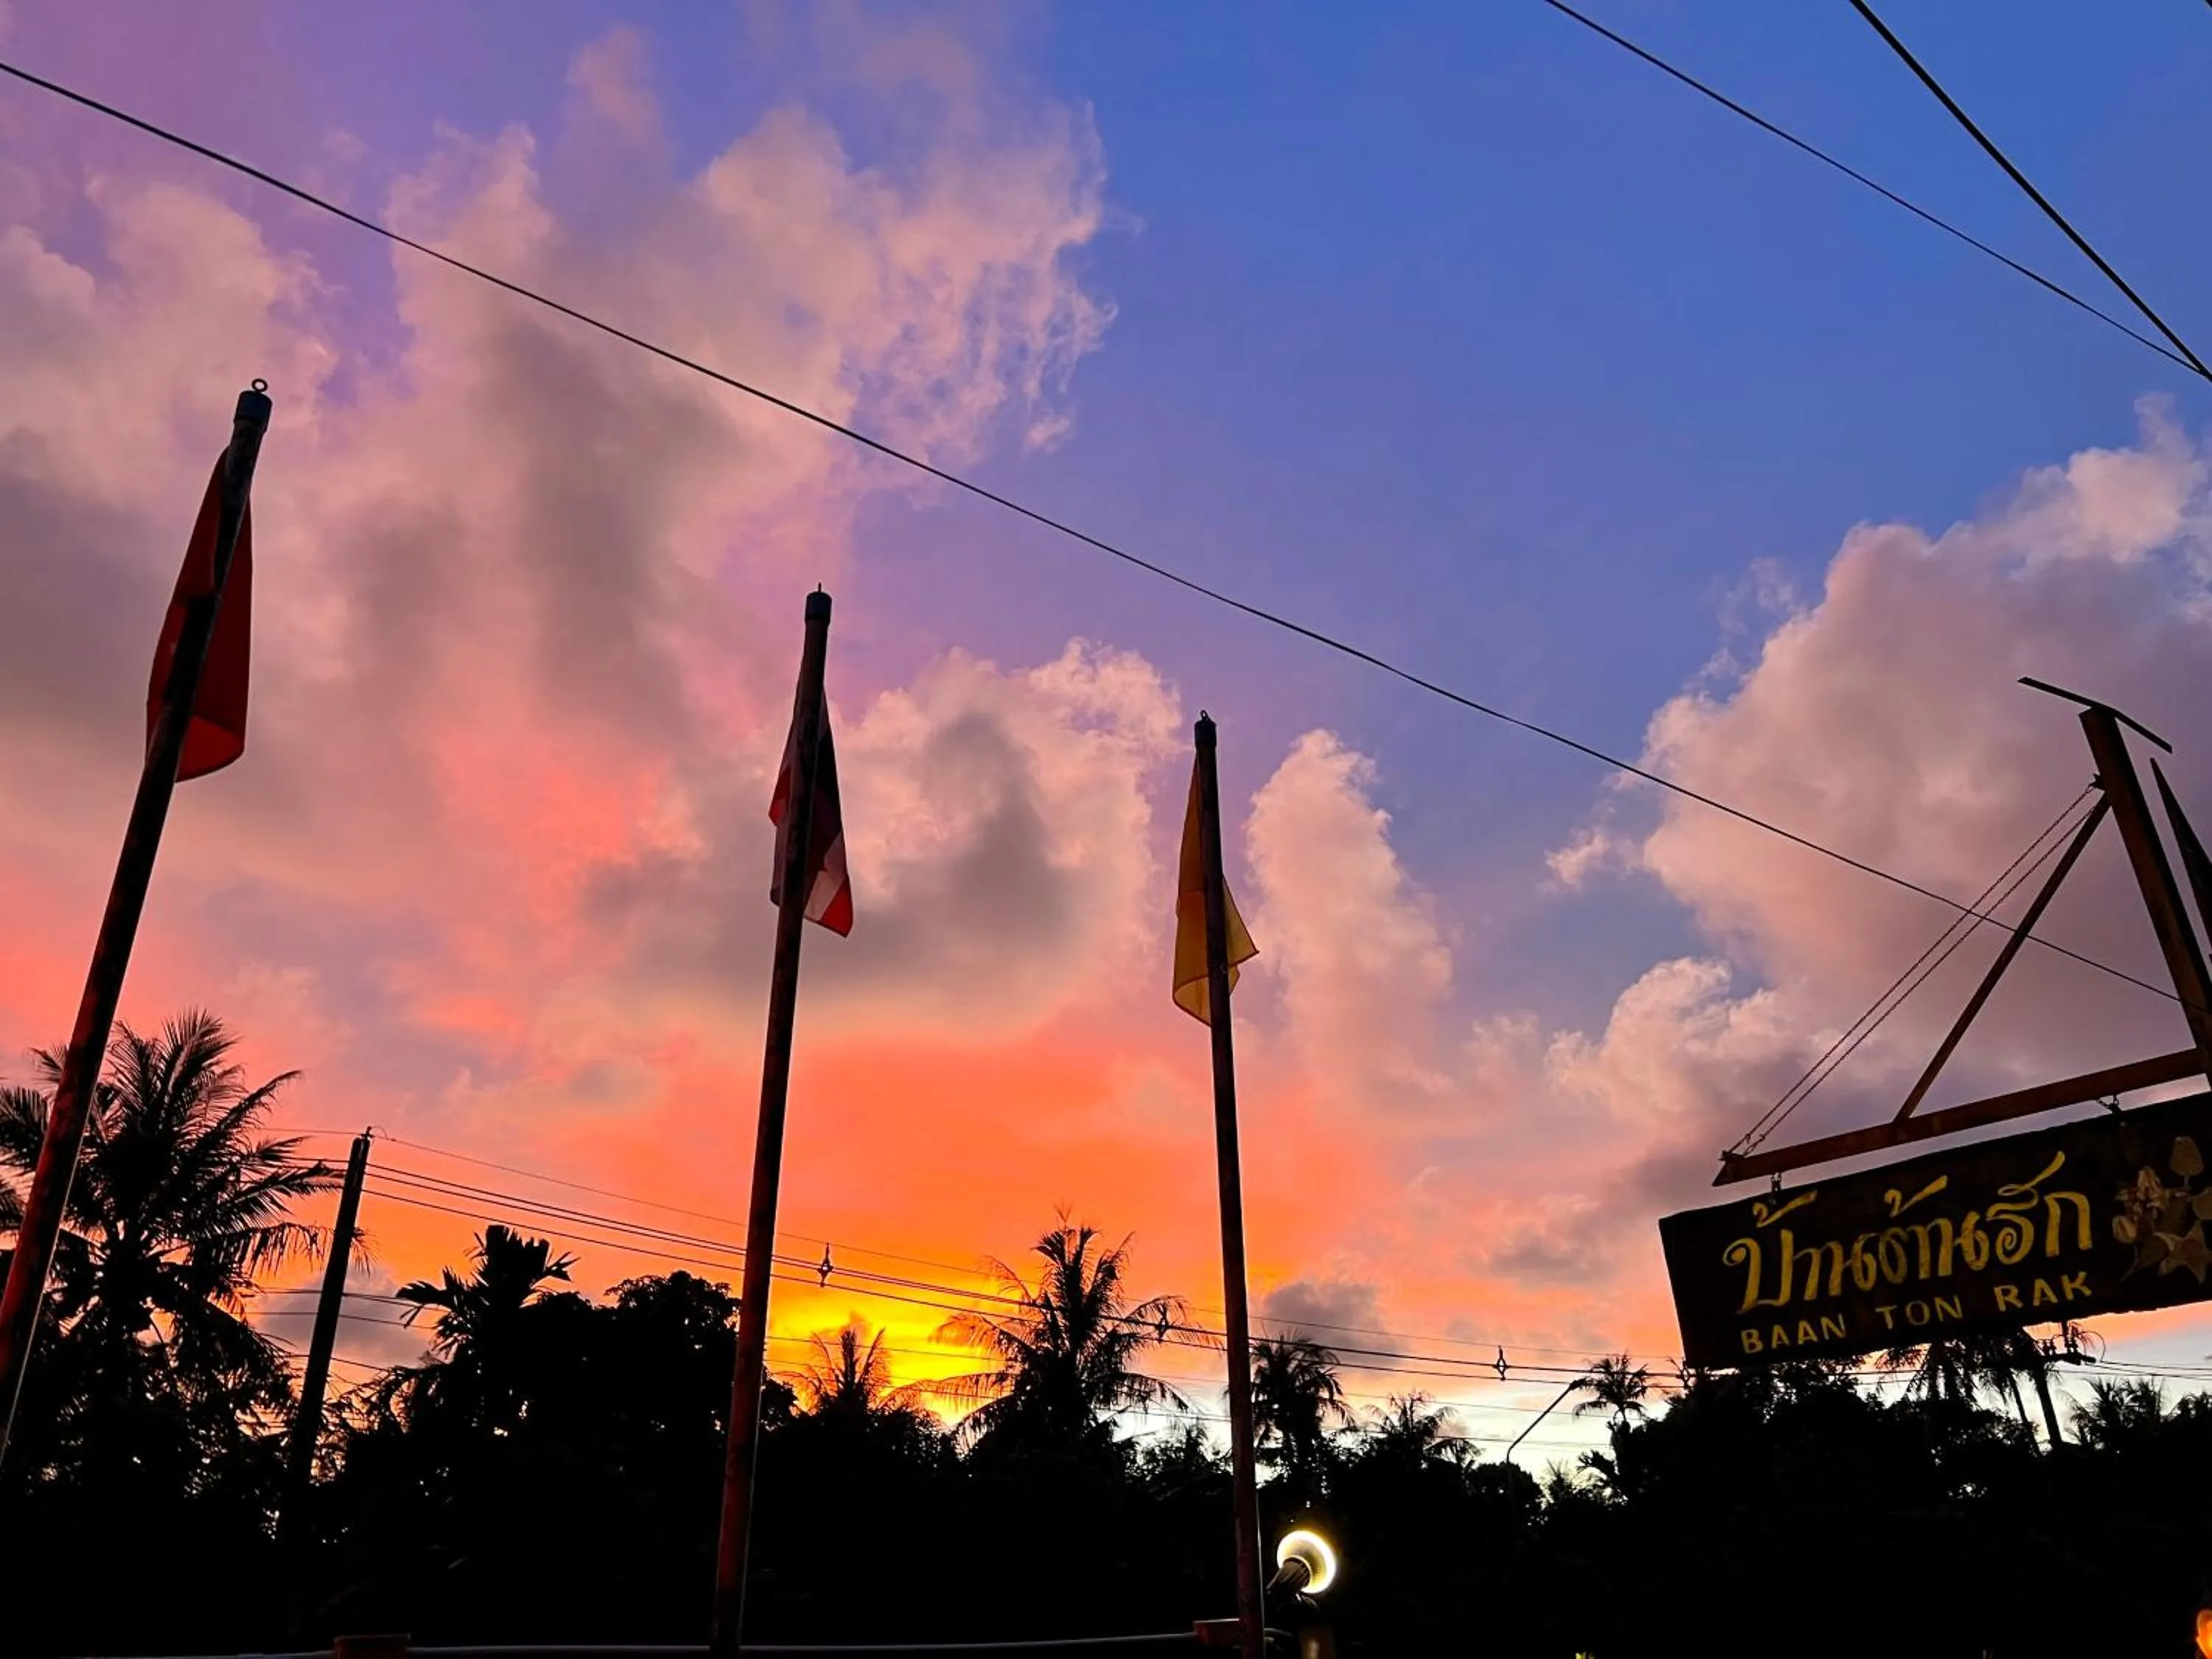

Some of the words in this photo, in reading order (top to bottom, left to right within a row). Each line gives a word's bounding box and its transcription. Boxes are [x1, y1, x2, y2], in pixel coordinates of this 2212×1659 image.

[1723, 1152, 2093, 1313] บ้านต้นรัก
[1741, 1314, 1846, 1354] BAAN
[1876, 1295, 1964, 1329] TON
[1994, 1272, 2093, 1311] RAK
